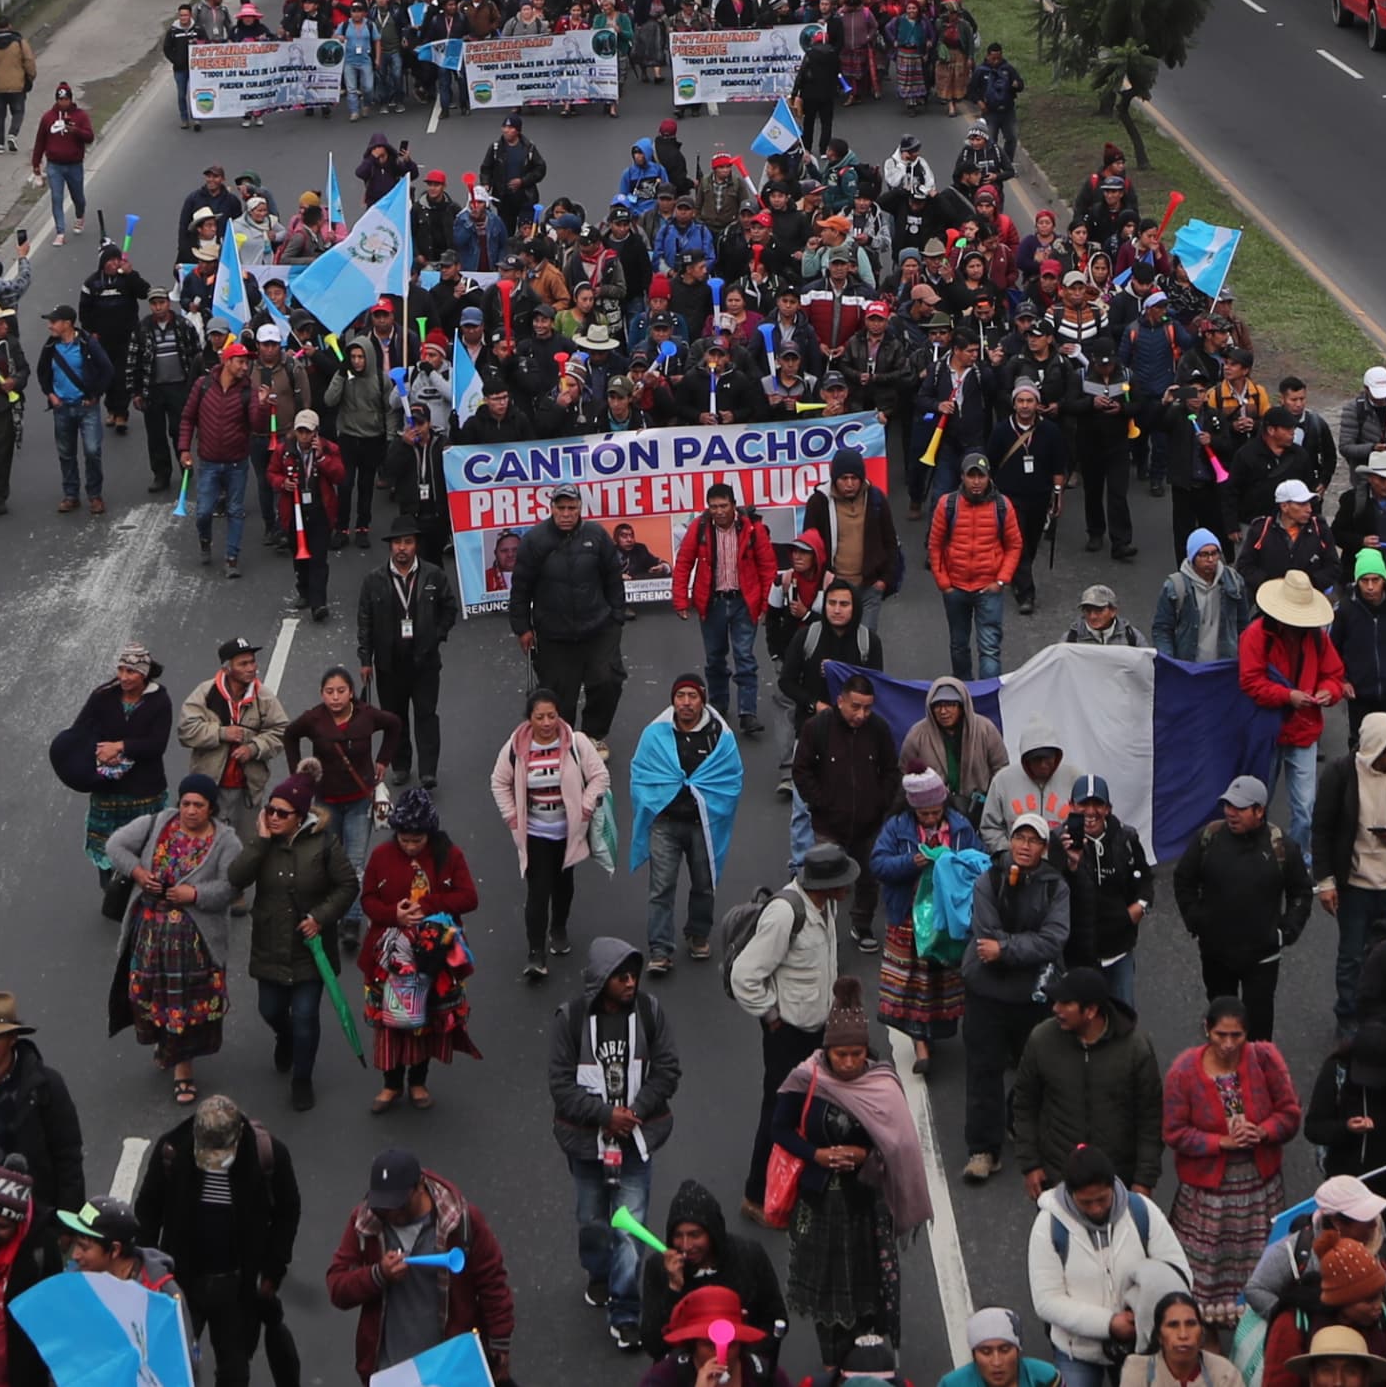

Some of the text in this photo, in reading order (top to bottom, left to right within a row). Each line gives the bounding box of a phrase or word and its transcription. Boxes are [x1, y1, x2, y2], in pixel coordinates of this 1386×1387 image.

[672, 44, 728, 56] PRESENTE
[190, 56, 247, 70] PRESENTE
[465, 50, 522, 64] PRESENTE
[719, 56, 740, 64] MALES
[513, 61, 535, 69] MALES
[546, 59, 555, 67] LA
[225, 70, 237, 78] LOS
[238, 69, 260, 77] MALES
[464, 422, 865, 485] CANTÓN PACHOC
[470, 478, 642, 528] PRESNTE
[651, 471, 694, 513] EN
[625, 590, 673, 603] UEREMO
[465, 600, 509, 614] RENUNC
